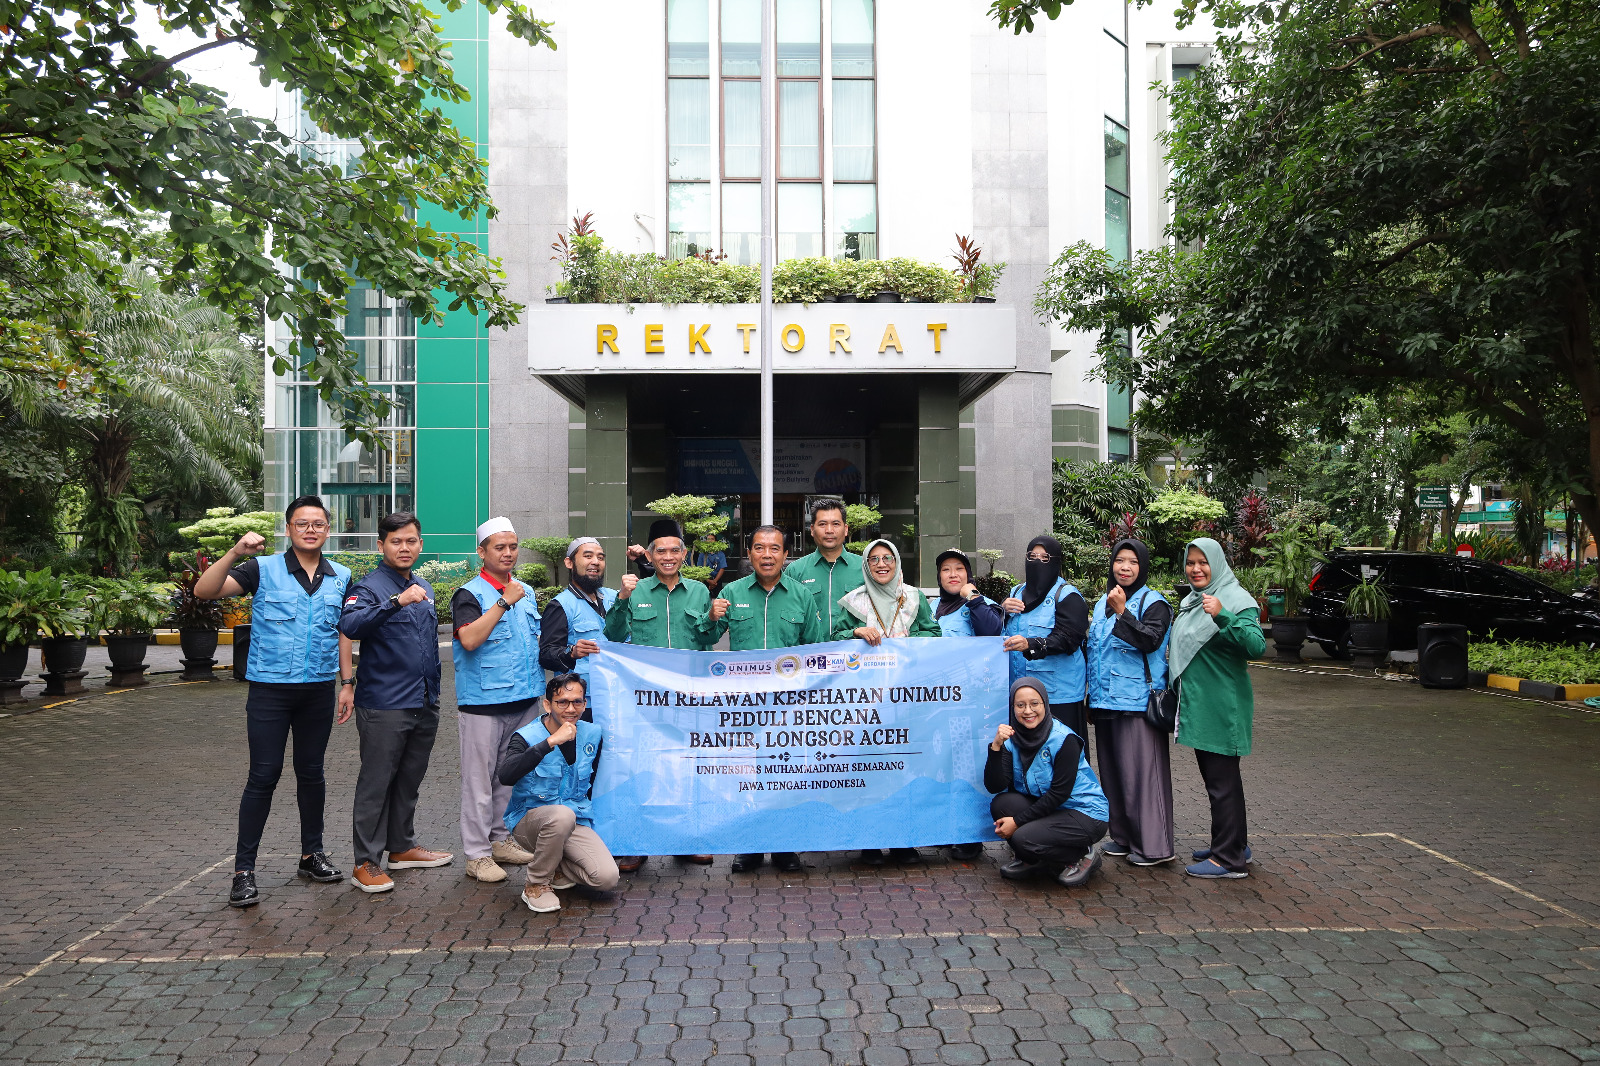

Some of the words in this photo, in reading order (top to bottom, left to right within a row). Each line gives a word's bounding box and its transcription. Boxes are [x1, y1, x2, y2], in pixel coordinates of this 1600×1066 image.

[596, 323, 948, 354] REKTORAT
[712, 459, 738, 467] UNGGUL
[704, 467, 728, 475] KAMPUS
[729, 664, 772, 673] UNIMUS
[634, 689, 670, 707] TIM
[675, 690, 768, 707] RELAWAN
[773, 687, 883, 706] KESEHATAN
[889, 685, 962, 703] UNIMUS
[719, 710, 788, 727] PEDULI
[793, 708, 882, 726] BENCANA
[689, 731, 760, 751] BANJIR,
[765, 729, 855, 748] LONGSOR
[859, 728, 909, 746] ACEH
[696, 765, 762, 775] UNIVERSITAS
[764, 763, 849, 774] MUHAMMADIYAH
[851, 761, 904, 772] SEMARANG
[738, 781, 765, 792] JAWA
[766, 778, 866, 791] TENGAH-INDONESIA
